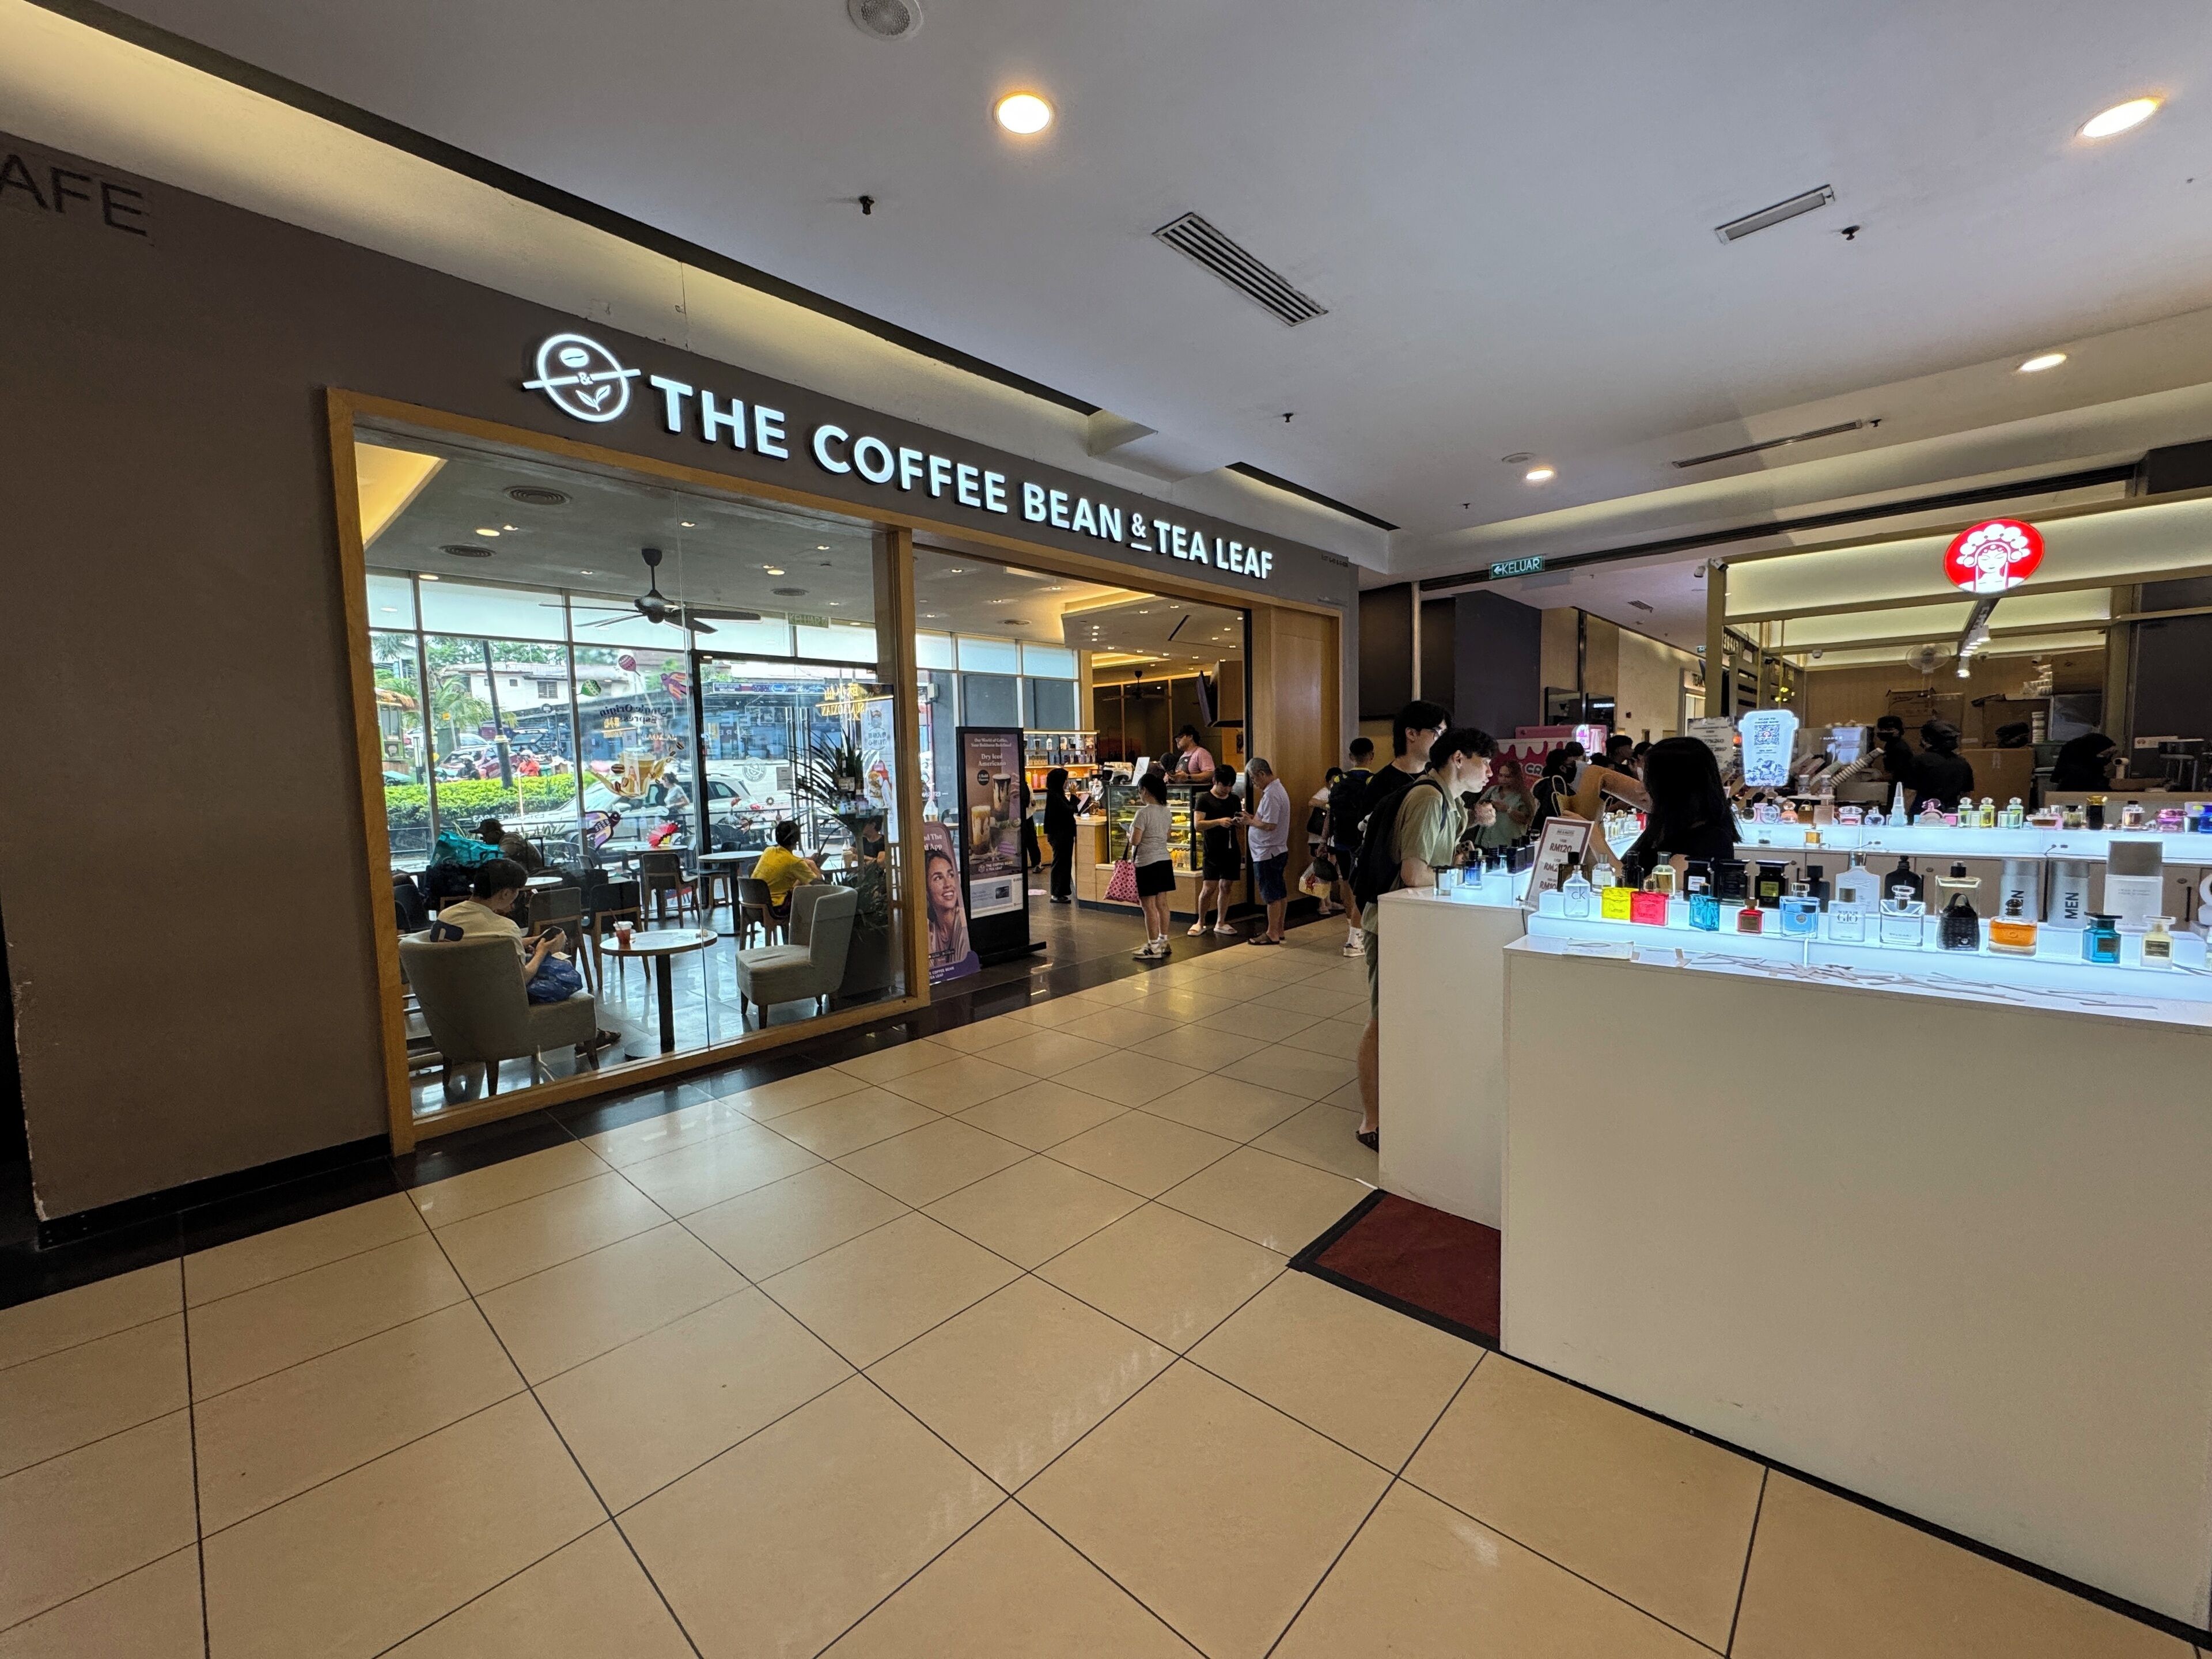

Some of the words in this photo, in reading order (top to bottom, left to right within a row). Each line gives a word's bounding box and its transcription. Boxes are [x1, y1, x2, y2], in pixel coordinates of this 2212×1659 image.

[649, 374, 789, 459] THE
[813, 425, 1007, 514] COFFEE
[1023, 482, 1122, 542] BEAN
[1131, 513, 1152, 547] &
[1153, 520, 1209, 565] TEA
[1215, 538, 1273, 579] LEAF
[1502, 558, 1540, 575] KELUAR
[1550, 843, 1572, 853] RM120
[1544, 862, 1558, 872] RM2
[1539, 881, 1556, 890] RM10
[2065, 892, 2079, 919] MEN
